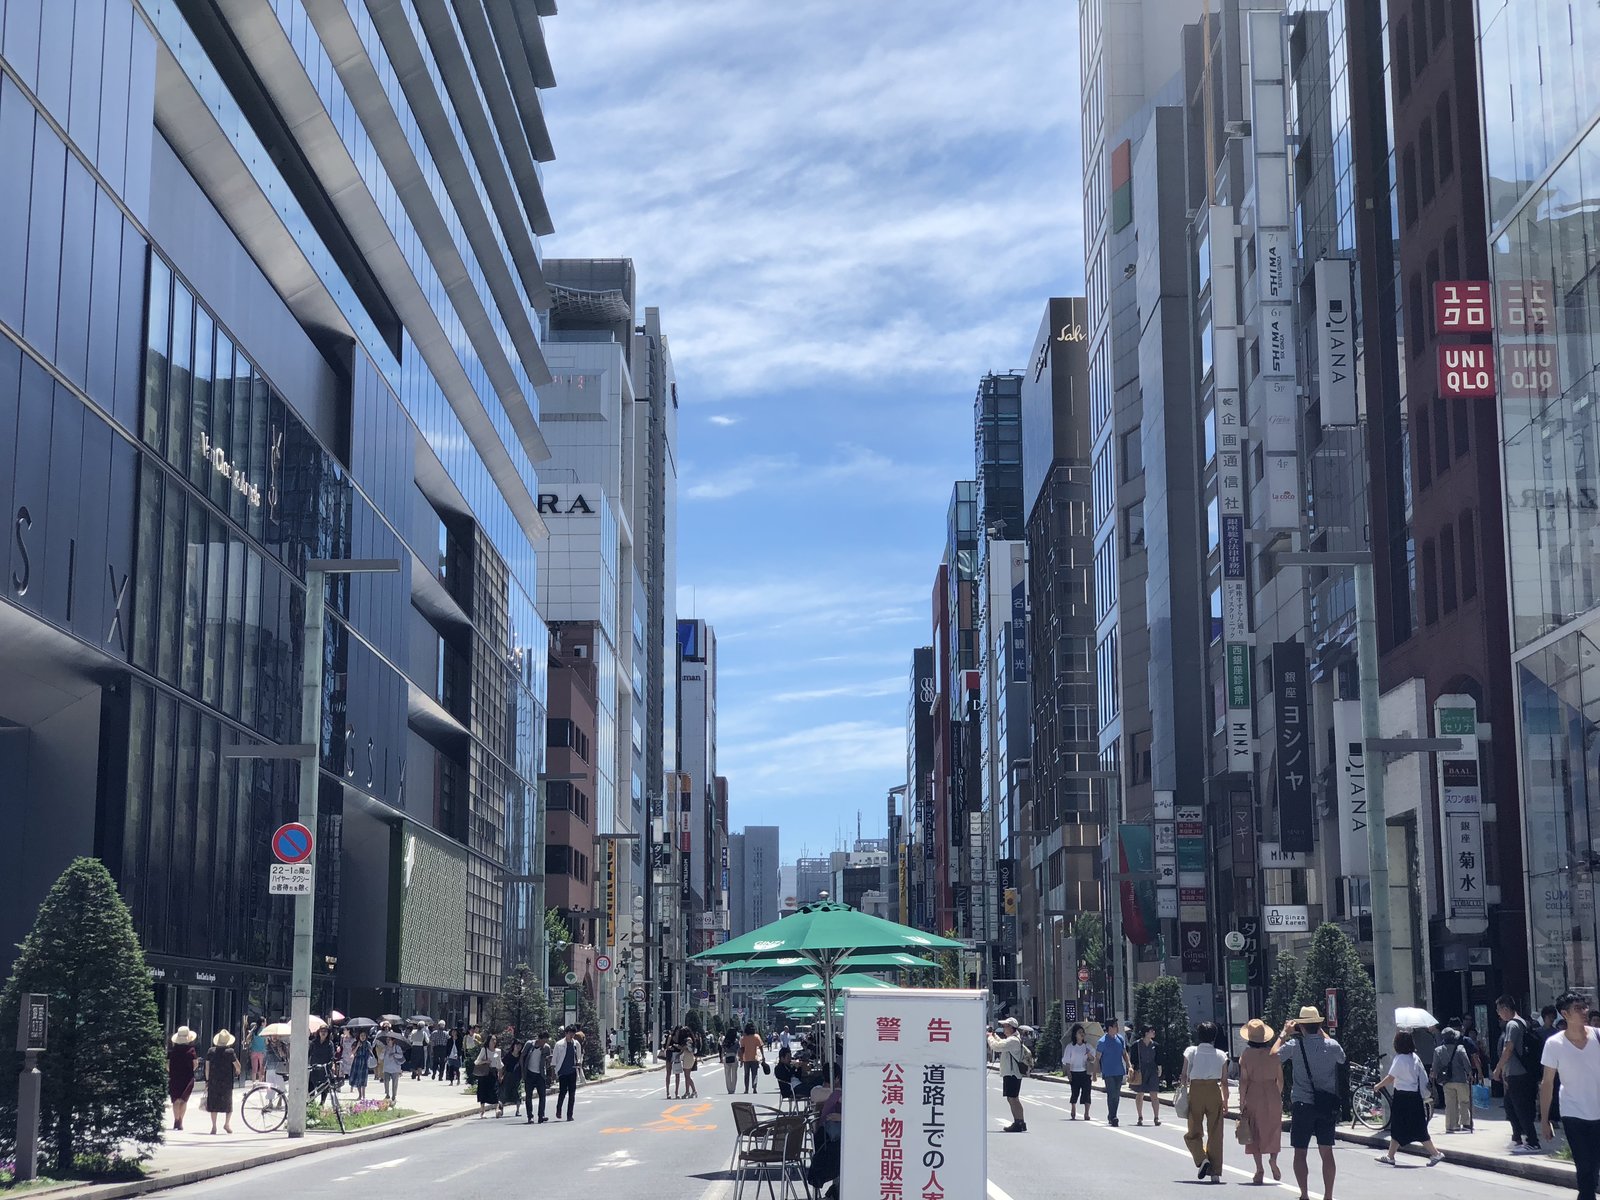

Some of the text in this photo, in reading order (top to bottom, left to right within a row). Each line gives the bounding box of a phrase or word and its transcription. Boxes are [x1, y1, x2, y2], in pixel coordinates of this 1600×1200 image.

[1269, 246, 1278, 296] SHIMA
[1443, 286, 1484, 303] ユニ
[1057, 323, 1088, 343] Salv
[1443, 307, 1485, 325] クロ
[1272, 321, 1281, 372] SHIMA
[1326, 299, 1348, 384] DIANA
[1445, 350, 1484, 368] UNI
[1447, 371, 1489, 393] QLO
[1221, 412, 1240, 510] 企画通信社
[1013, 598, 1025, 670] 名鉄観光
[1231, 645, 1245, 705] 西銀座診療所
[1232, 722, 1249, 756] MINX
[1283, 671, 1304, 791] 銀座 ヨシノヤ
[1443, 723, 1473, 732] セリナ
[1345, 742, 1367, 832] DIANA
[1235, 811, 1249, 856] マギー
[653, 845, 662, 868] ダンス
[1458, 821, 1477, 892] 銀座 菊水
[1544, 890, 1592, 901] SUMER
[1232, 934, 1239, 942] 5
[875, 1016, 952, 1043] 警告
